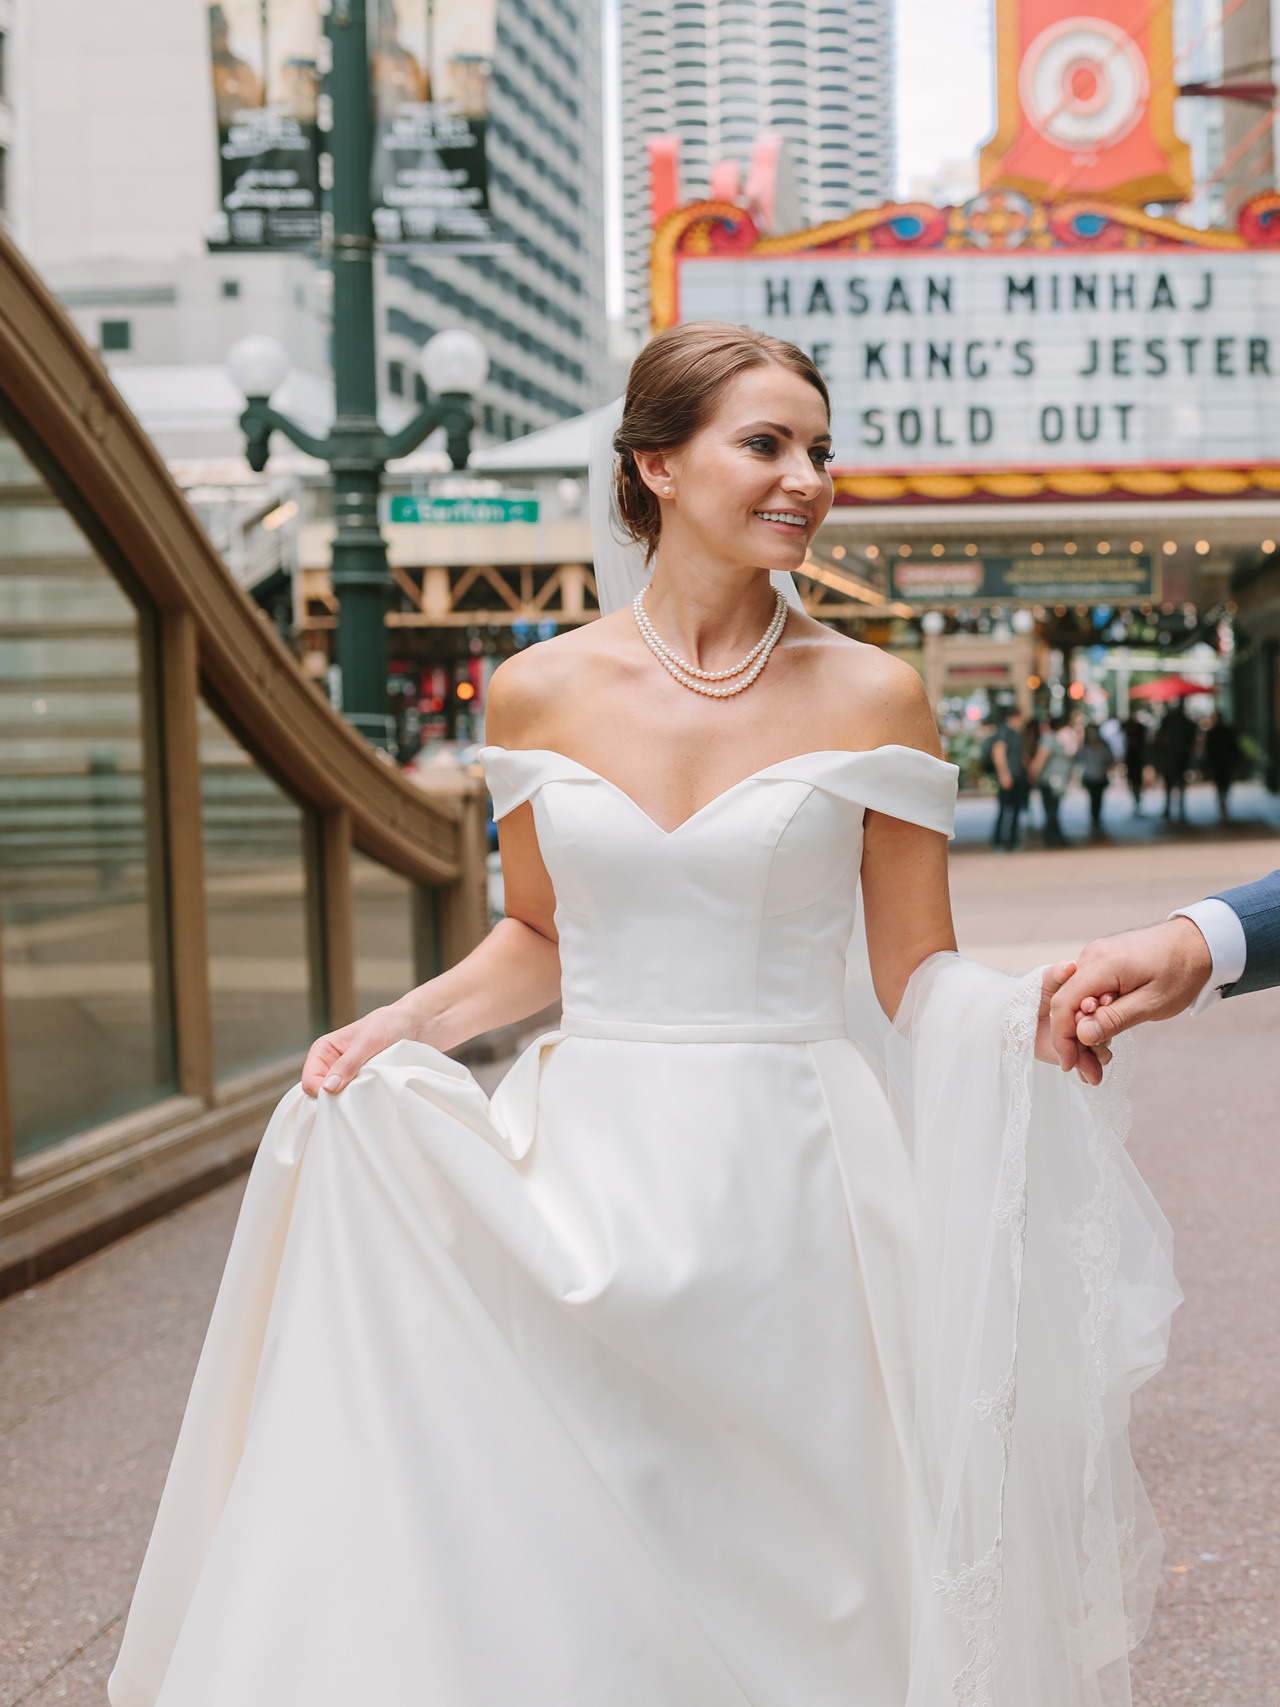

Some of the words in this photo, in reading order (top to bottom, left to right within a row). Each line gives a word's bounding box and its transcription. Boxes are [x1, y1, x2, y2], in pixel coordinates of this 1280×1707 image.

[764, 276, 952, 317] HASAN
[1006, 272, 1214, 311] MINHAJ
[864, 340, 1035, 380] KING'S
[1080, 337, 1272, 377] JESTER
[861, 406, 994, 448] SOLD
[1040, 405, 1134, 444] OUT
